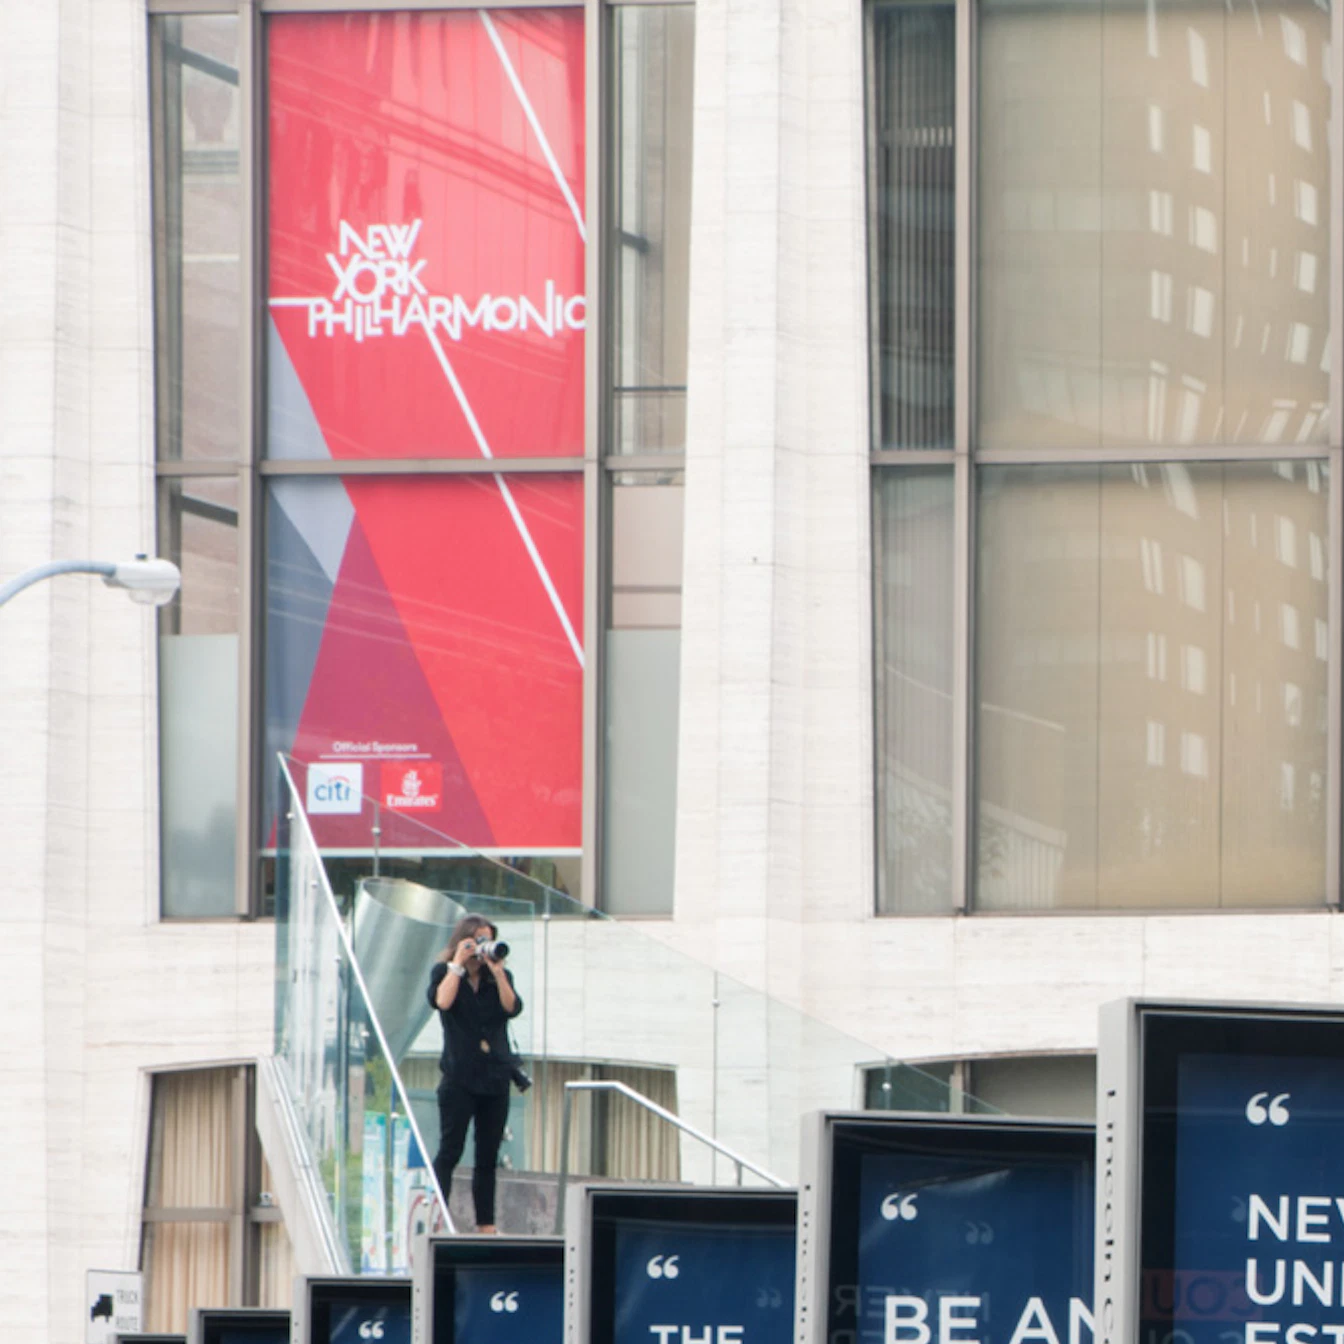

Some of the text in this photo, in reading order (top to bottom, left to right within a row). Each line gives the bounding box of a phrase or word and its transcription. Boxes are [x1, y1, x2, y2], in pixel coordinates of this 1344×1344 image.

[339, 218, 422, 259] NEW
[325, 253, 428, 302] YORK
[308, 280, 586, 342] PHILHARMONIC
[314, 782, 350, 801] citi
[386, 794, 436, 807] Emirates
